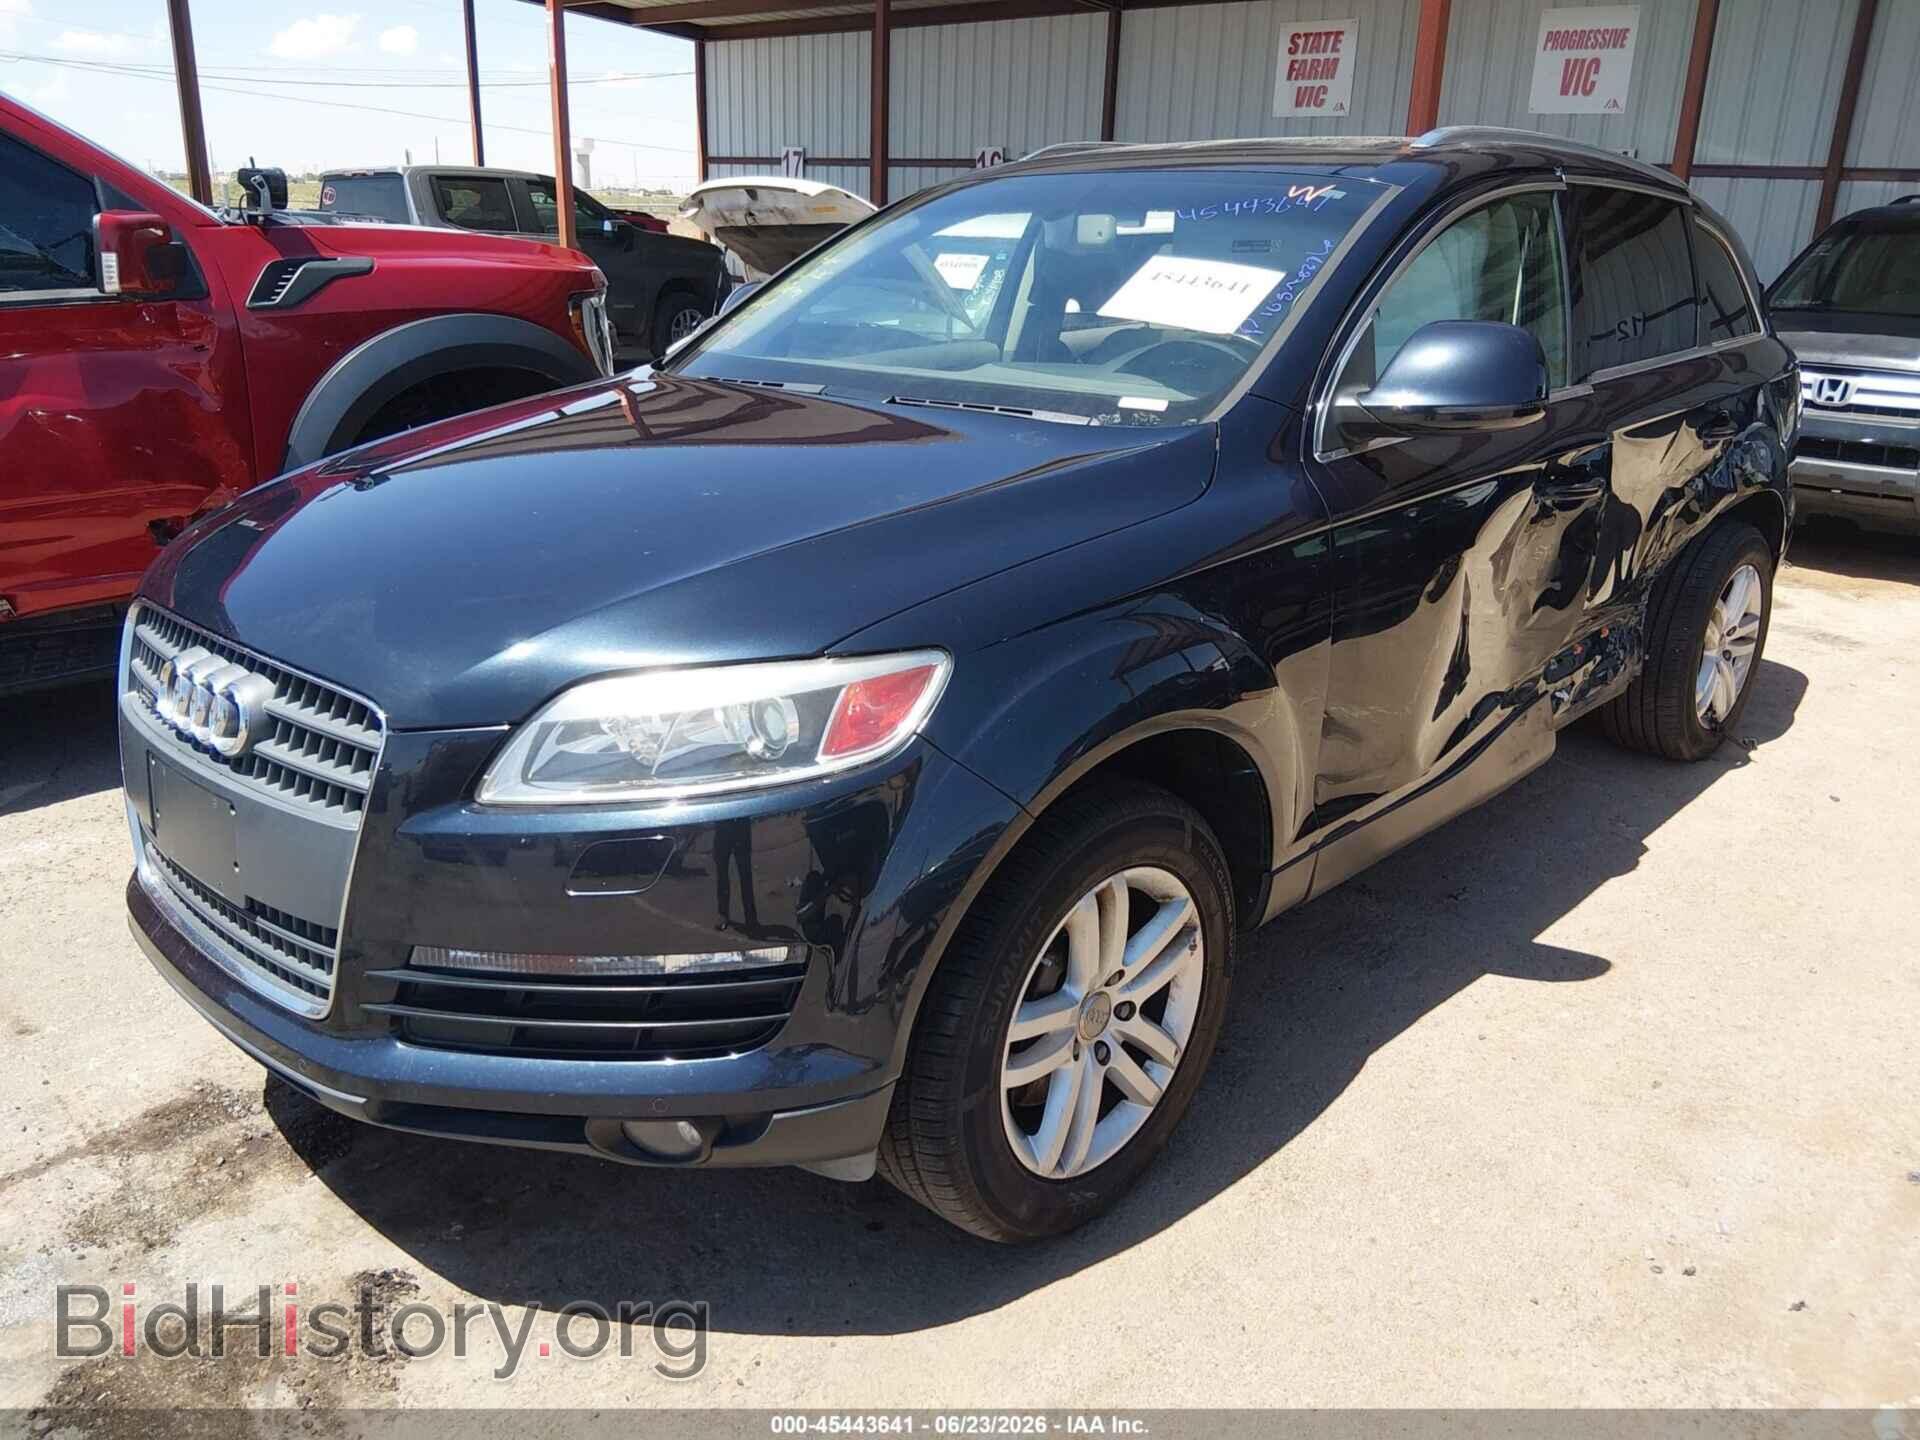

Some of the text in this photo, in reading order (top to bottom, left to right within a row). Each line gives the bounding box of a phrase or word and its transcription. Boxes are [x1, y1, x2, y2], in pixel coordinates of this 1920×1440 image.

[1287, 30, 1344, 55] STATE
[1543, 27, 1630, 51] PROGRESSIVE
[1286, 57, 1339, 81] FARM
[1560, 57, 1601, 96] VIC
[1295, 85, 1328, 108] VIC
[782, 150, 803, 177] 17
